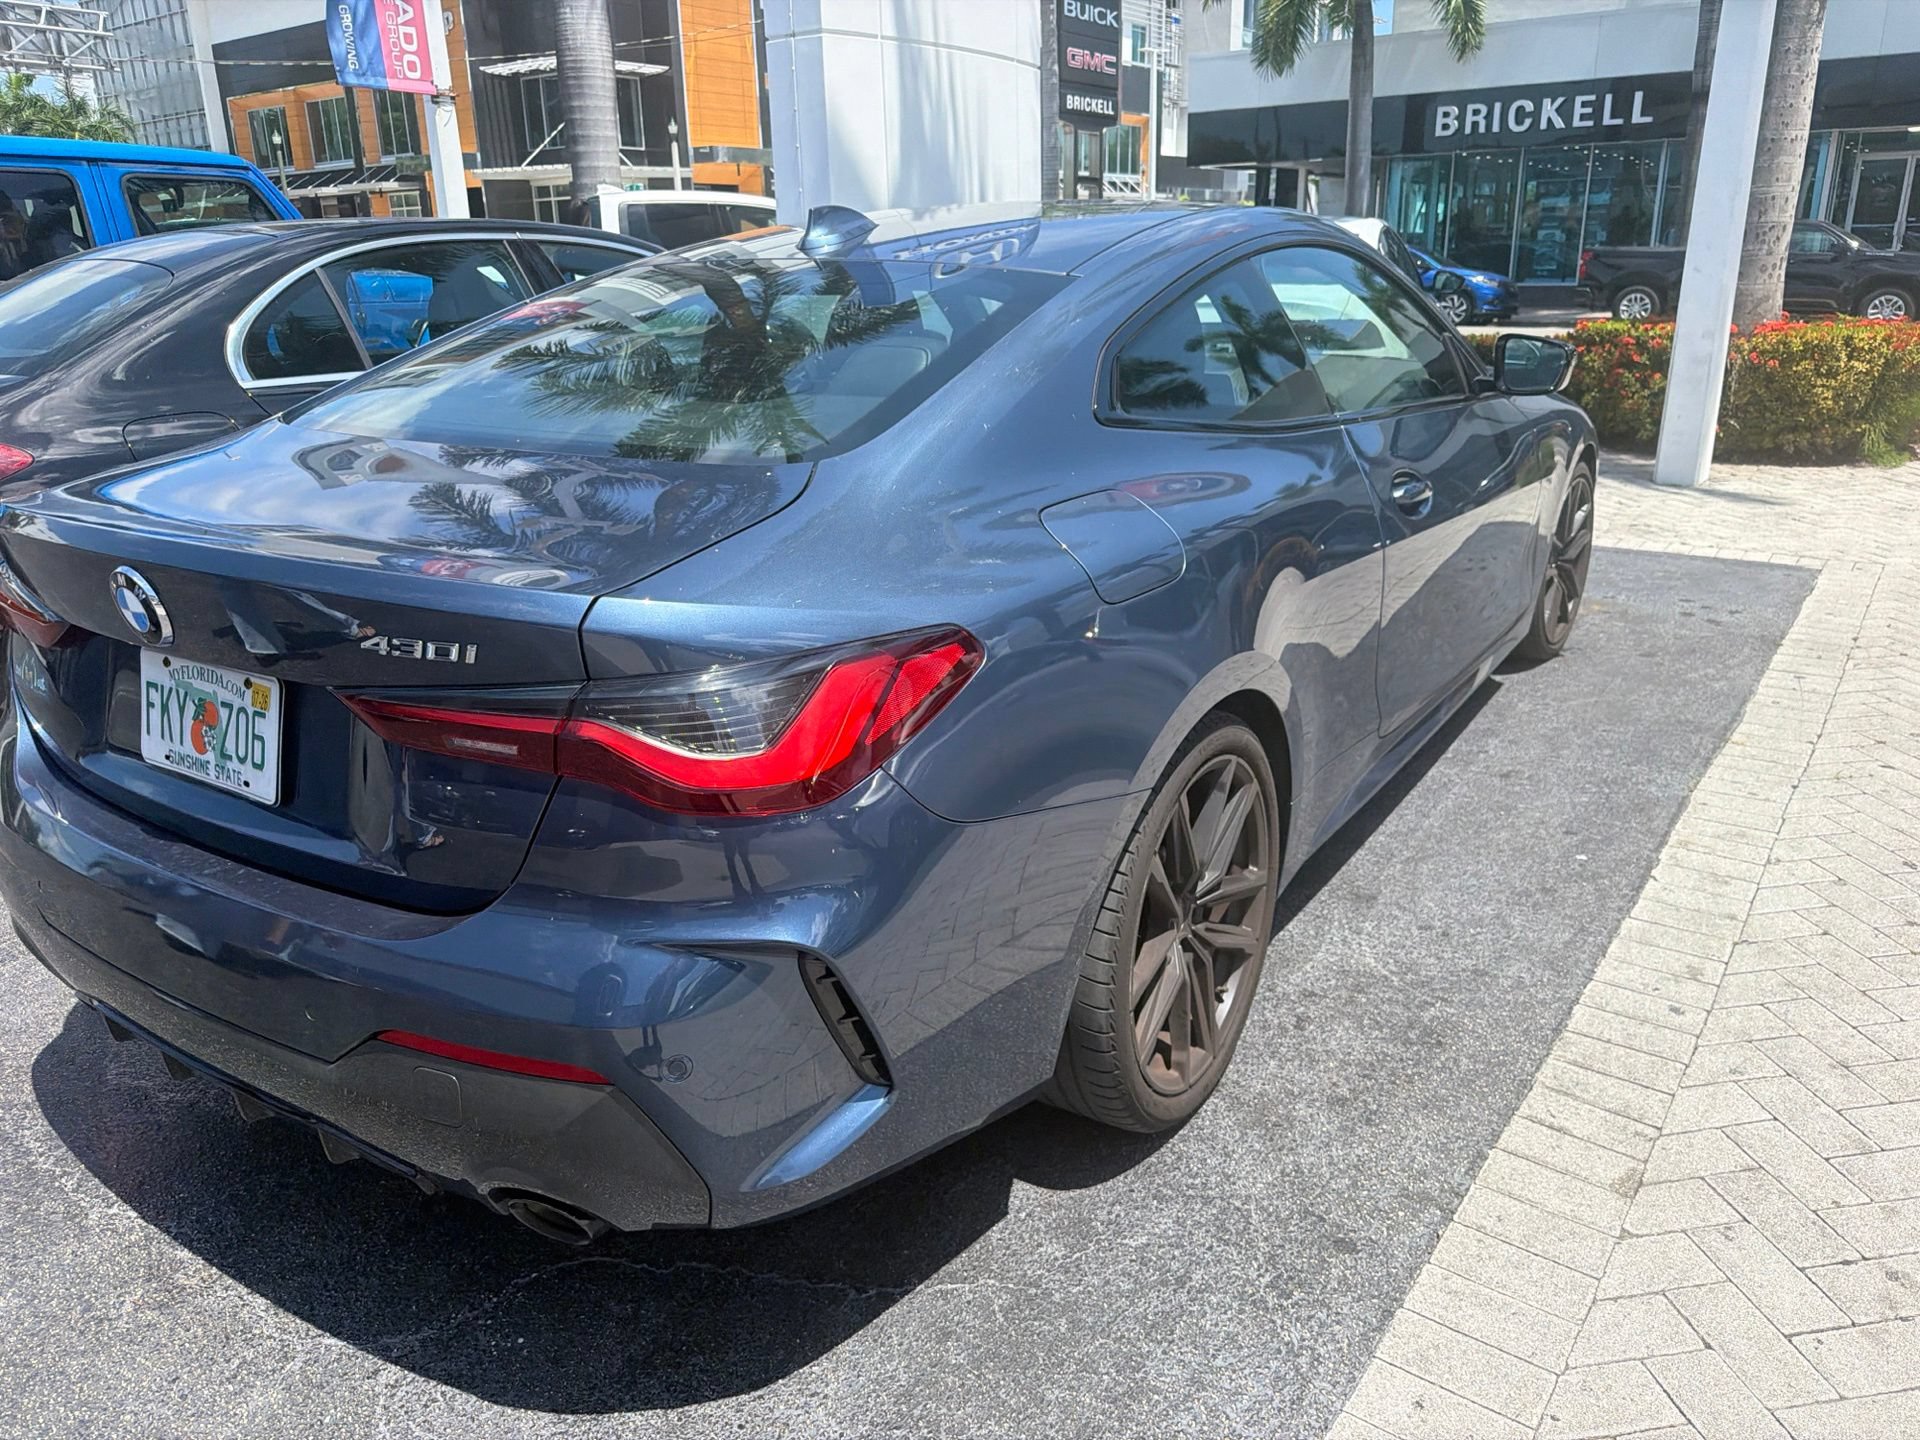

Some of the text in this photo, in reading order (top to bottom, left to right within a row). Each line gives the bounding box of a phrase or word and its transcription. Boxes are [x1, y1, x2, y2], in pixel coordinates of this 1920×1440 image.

[1064, 0, 1119, 28] BUICK
[385, 11, 404, 79] GROUP
[1066, 47, 1117, 75] GMC
[1066, 94, 1115, 115] BRICKELL
[1434, 90, 1654, 137] BRICKELL
[145, 680, 267, 772] FKY Z06
[168, 749, 243, 788] SUNSHINE STATE
